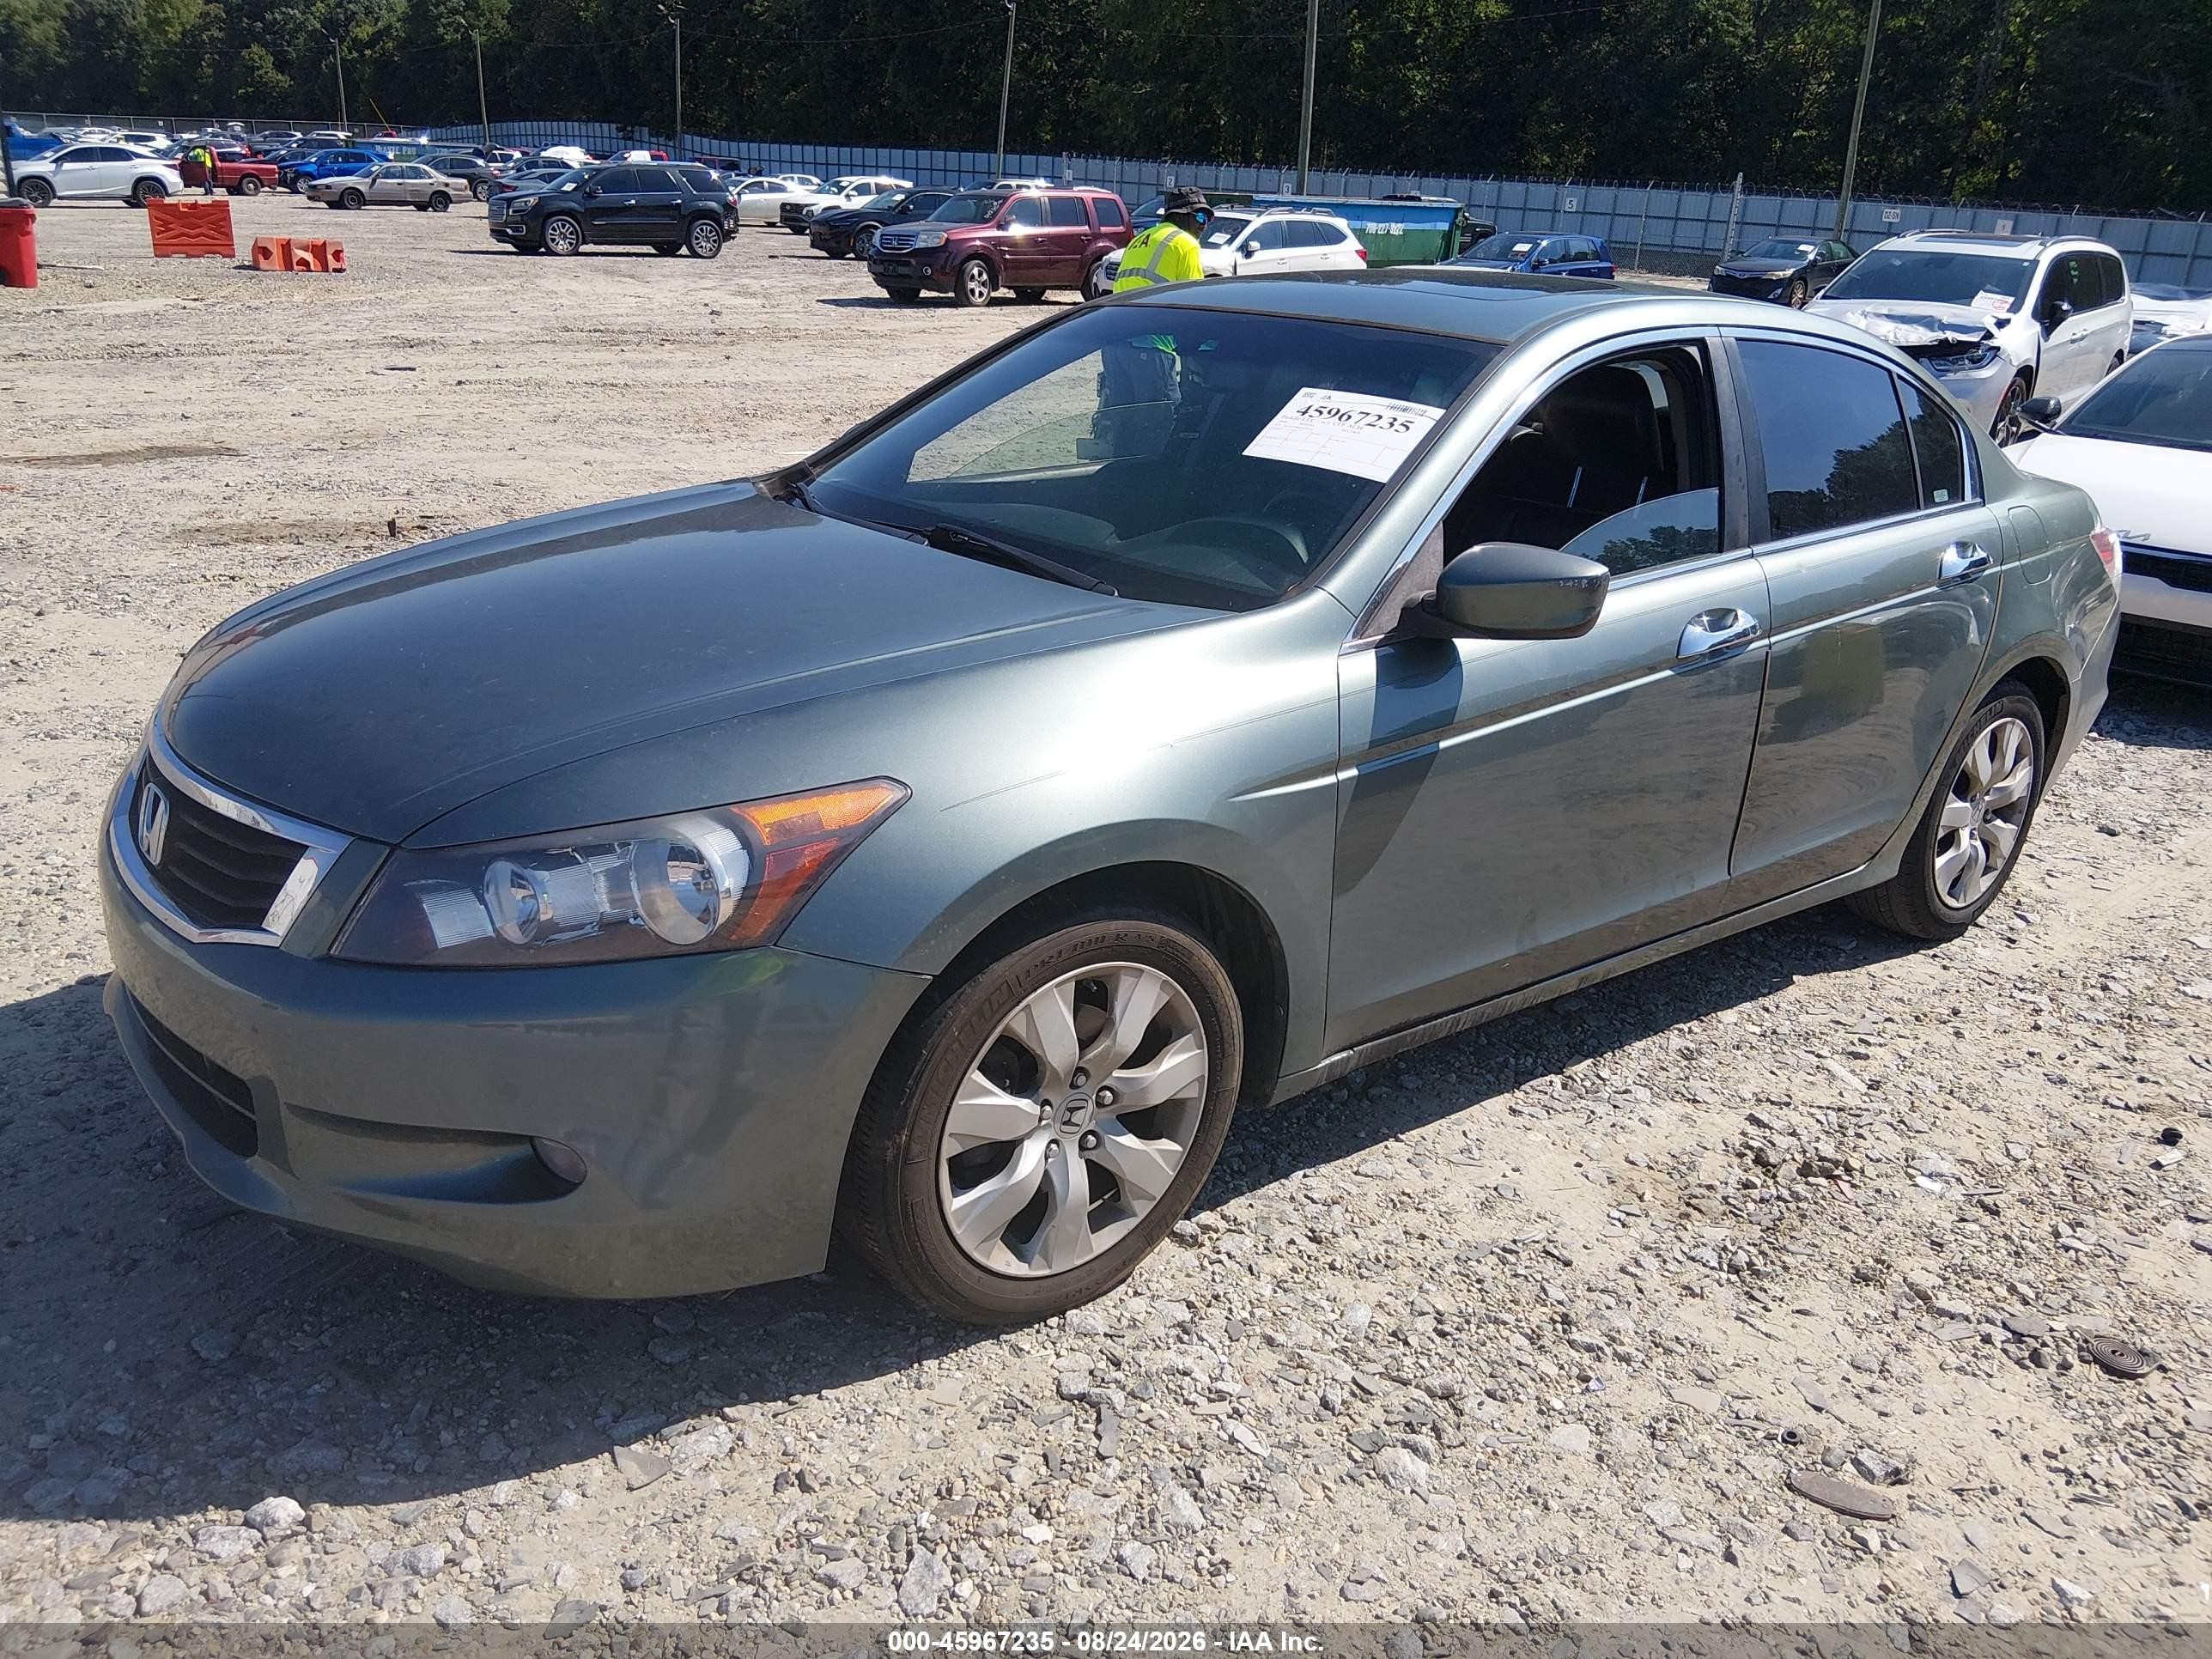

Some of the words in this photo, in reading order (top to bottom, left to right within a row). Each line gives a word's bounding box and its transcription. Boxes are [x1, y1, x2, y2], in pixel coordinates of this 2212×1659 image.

[1168, 178, 1173, 186] 2
[1285, 185, 1290, 194] 3
[1568, 199, 1574, 209] 5
[1297, 404, 1415, 434] 45967235
